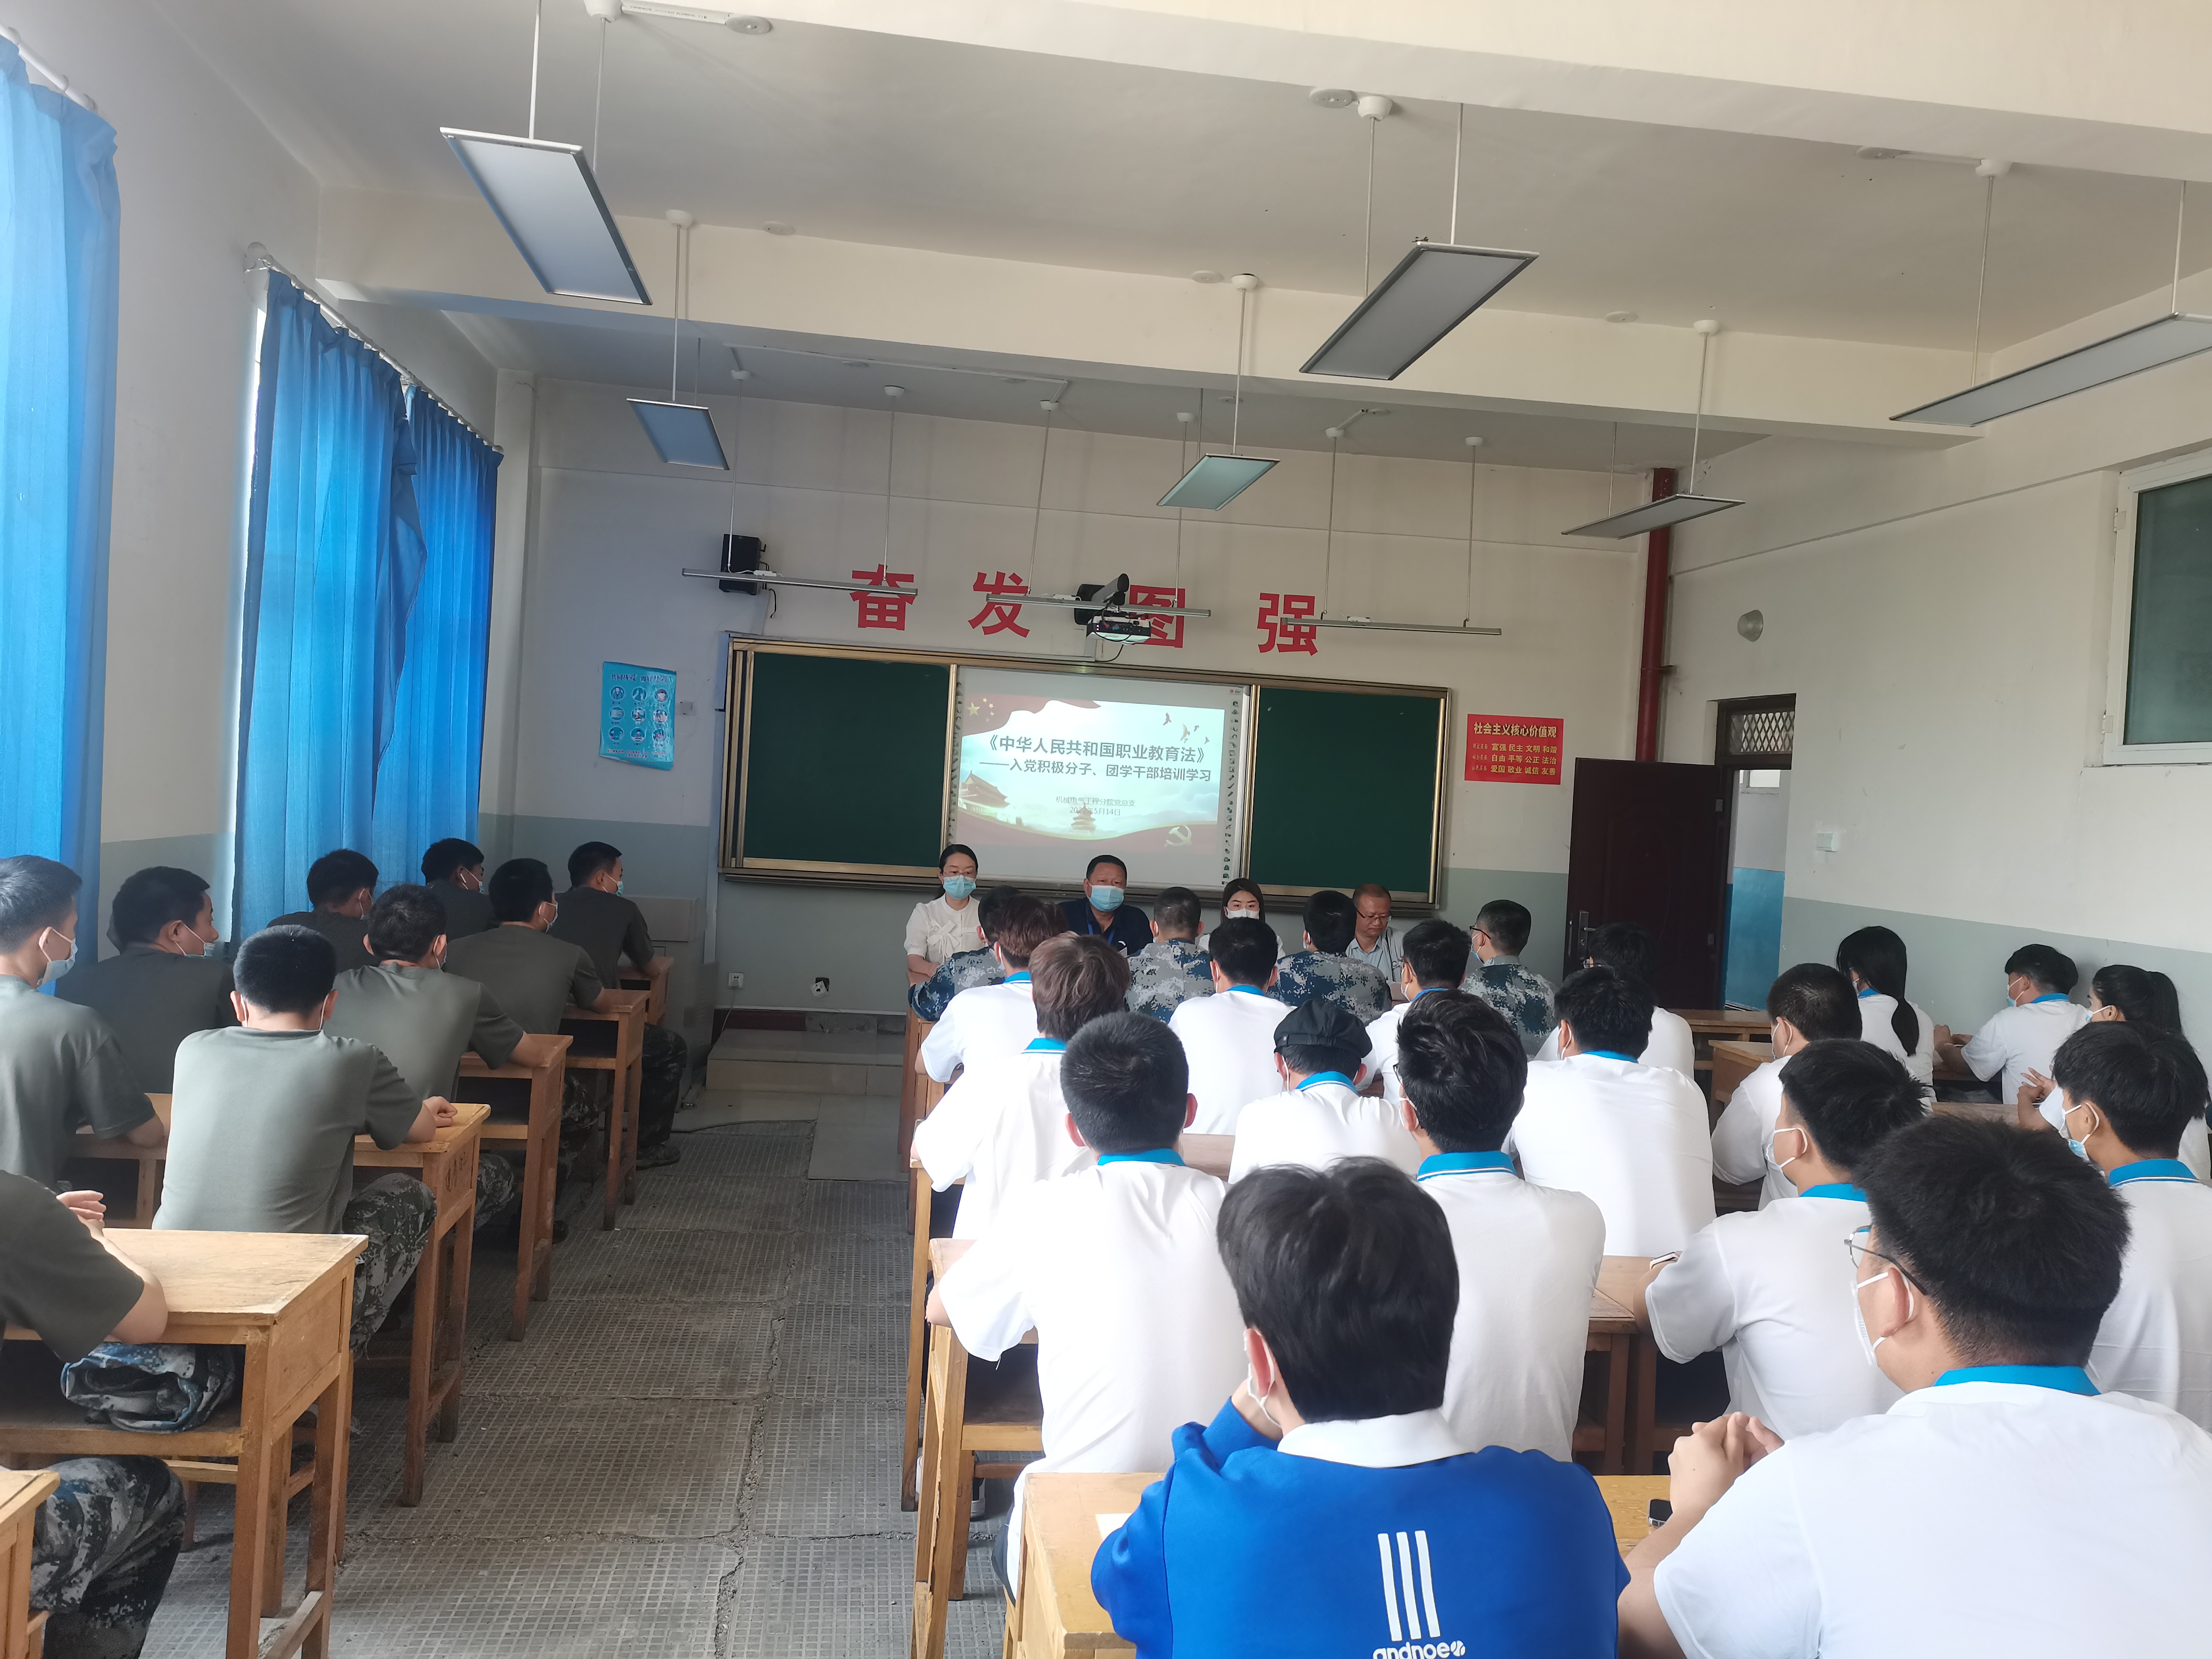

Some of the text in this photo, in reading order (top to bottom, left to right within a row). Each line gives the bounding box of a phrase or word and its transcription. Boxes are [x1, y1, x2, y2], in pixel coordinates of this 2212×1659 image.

[850, 564, 1318, 656] 奋发图强
[1473, 722, 1557, 737] 社会主义核心价值观
[990, 734, 1204, 763] 《中华人民共和国职业教育法》
[1491, 743, 1507, 751] 富强
[1526, 745, 1540, 753] 文明
[1542, 745, 1557, 754] 和谐
[1508, 755, 1523, 763] 平等
[1491, 765, 1505, 773] 爱国
[1507, 766, 1522, 774] 敬业
[1525, 766, 1539, 775] 诚信
[1541, 768, 1556, 776] 友善
